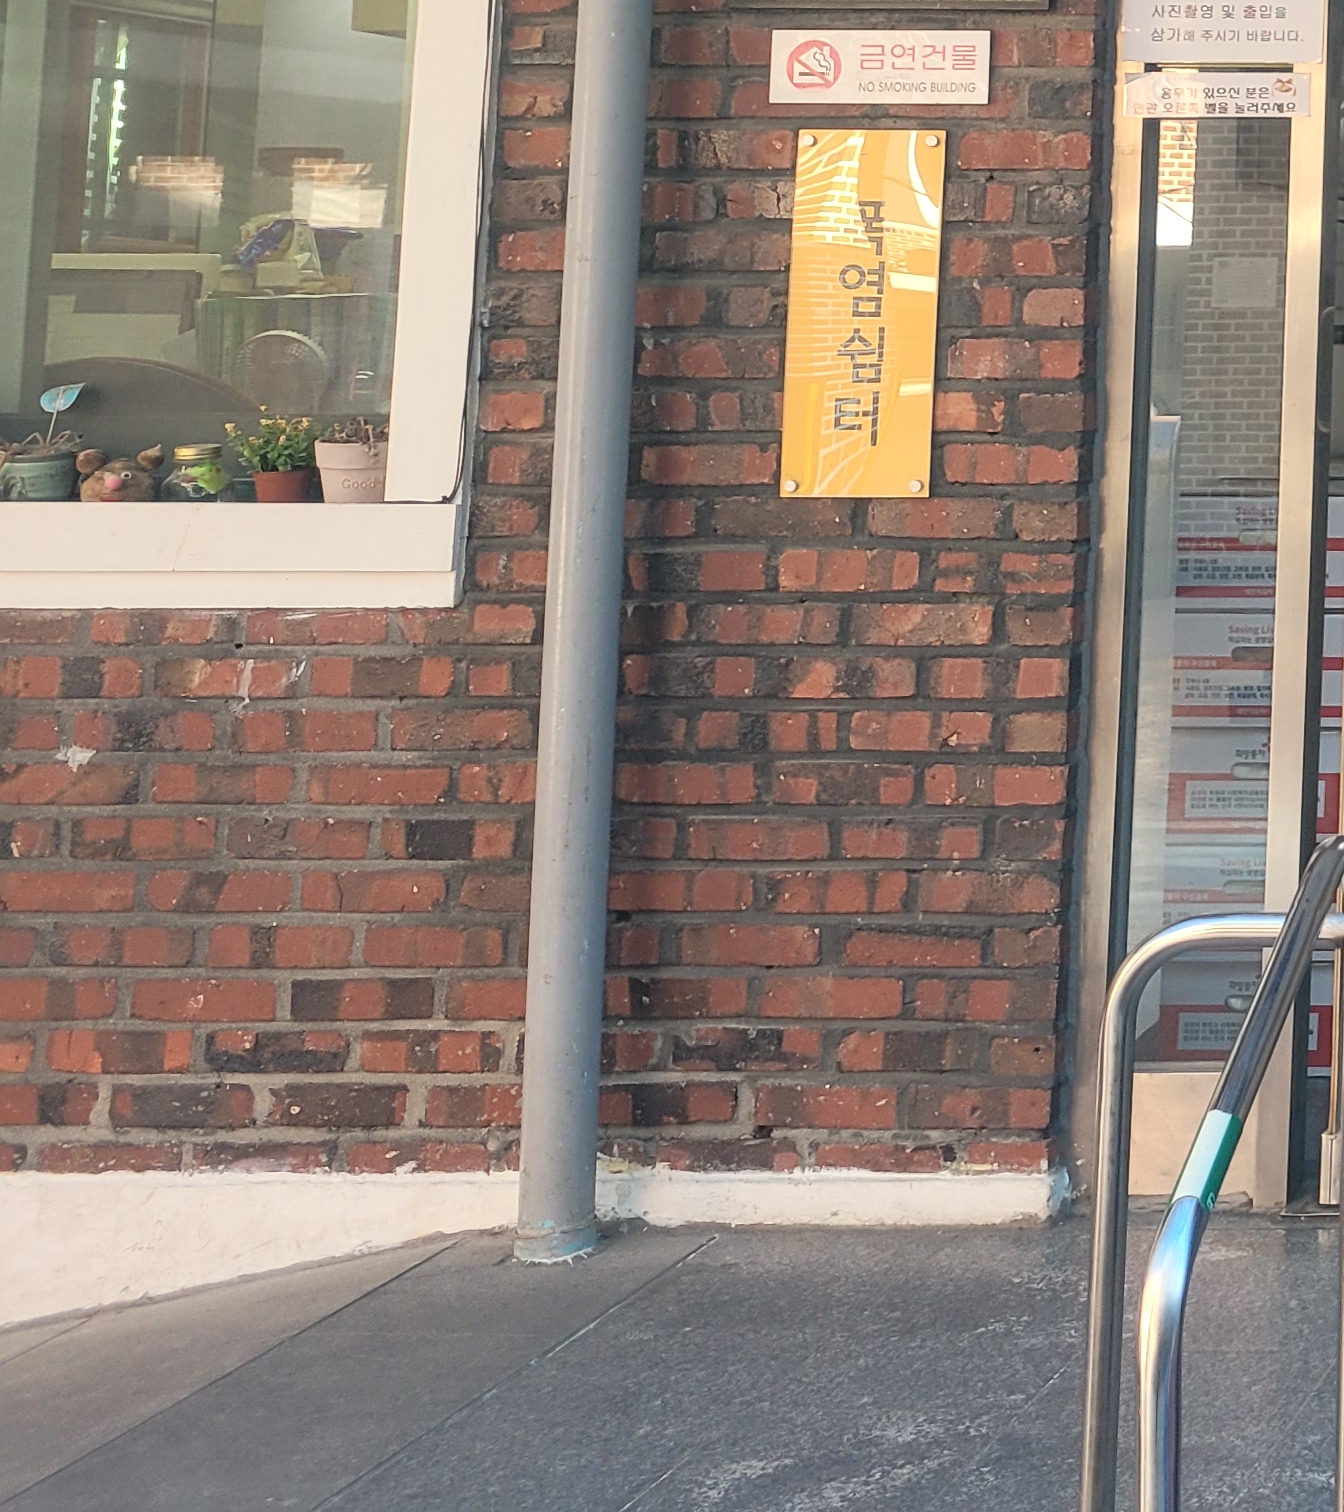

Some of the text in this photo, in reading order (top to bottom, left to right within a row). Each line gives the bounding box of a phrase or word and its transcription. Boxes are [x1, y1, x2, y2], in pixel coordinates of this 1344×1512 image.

[1151, 4, 1287, 19] 사진촬영 및 출입을
[1201, 28, 1240, 42] 주시기
[1247, 28, 1305, 42] 바랍니다.
[859, 44, 978, 71] 금연건물
[858, 81, 976, 93] NO SMOKING BUILDING
[1203, 87, 1240, 99] 있으신
[1245, 87, 1270, 99] 분은
[1234, 102, 1297, 114] 눌러주세요
[341, 476, 376, 489] Good
